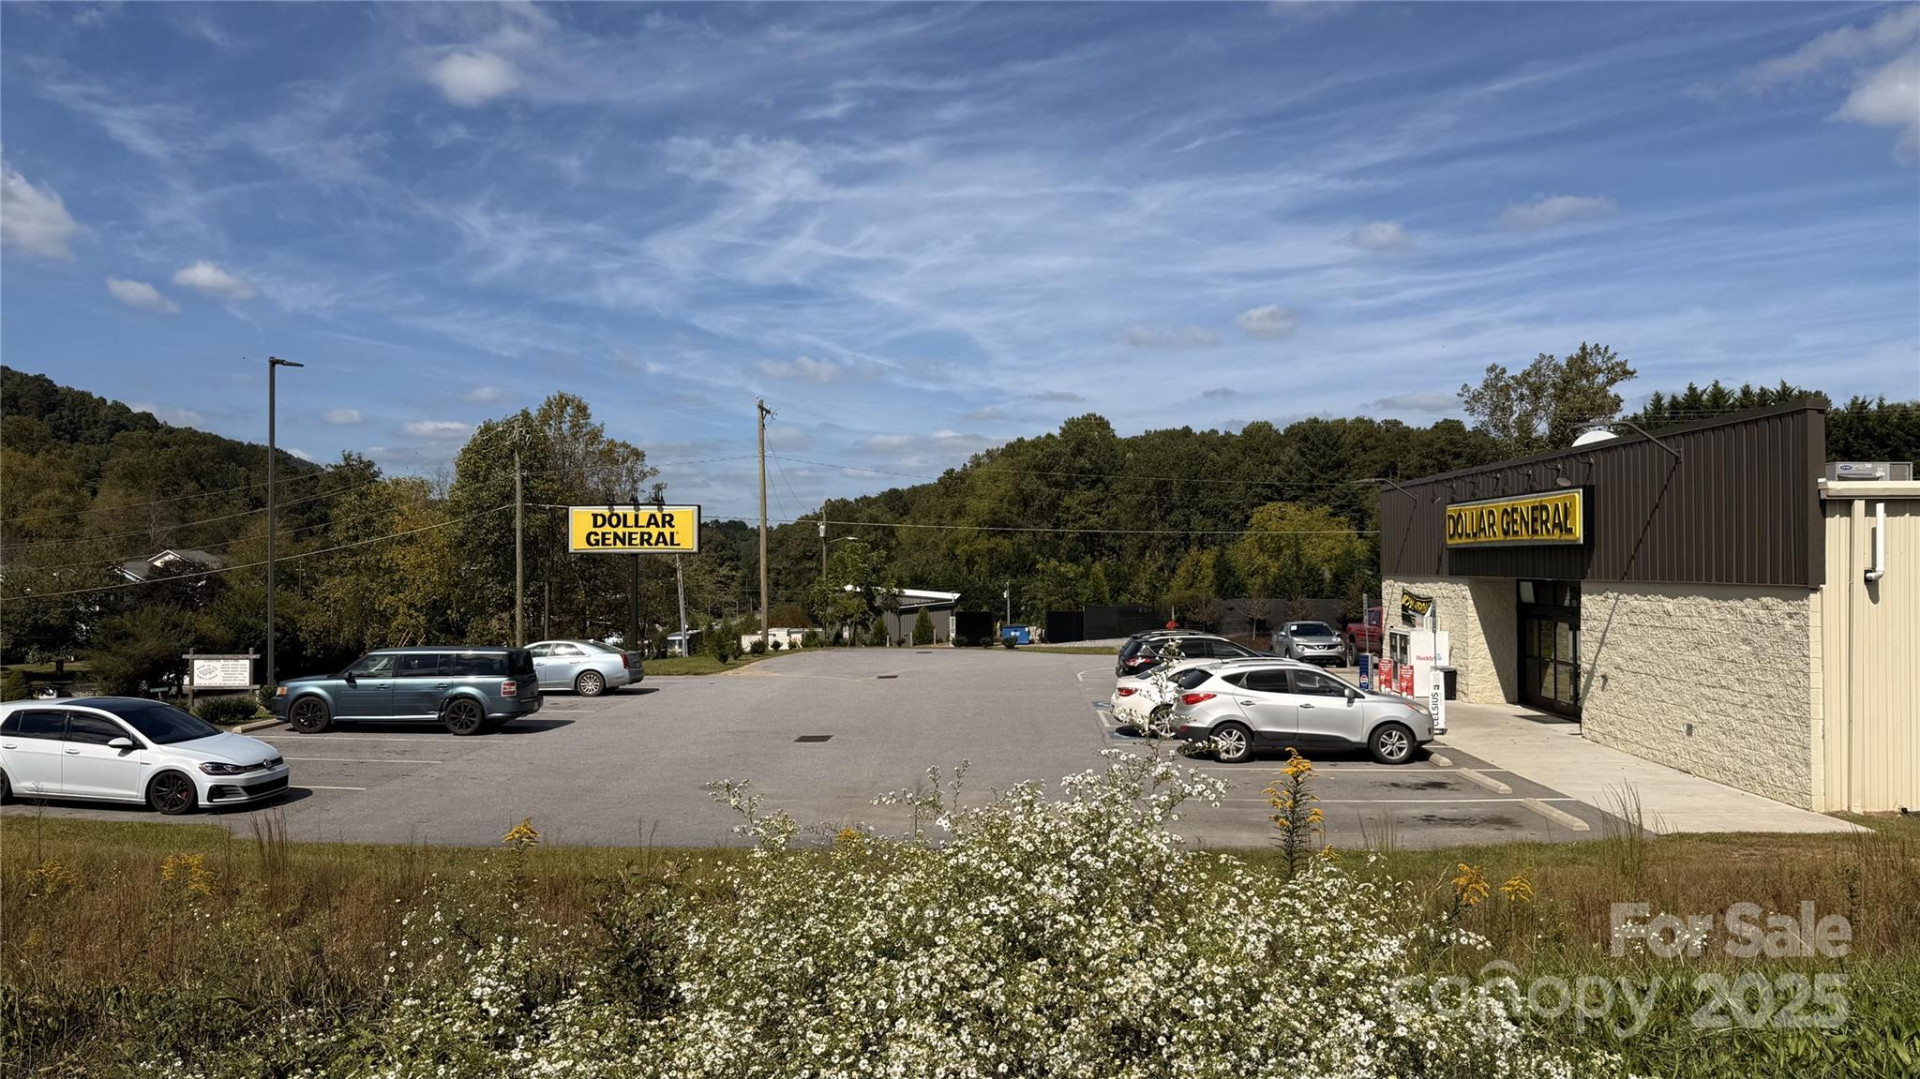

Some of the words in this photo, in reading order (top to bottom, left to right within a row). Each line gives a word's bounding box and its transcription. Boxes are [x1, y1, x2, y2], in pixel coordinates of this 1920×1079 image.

[591, 513, 675, 529] DOLLAR
[1447, 508, 1497, 539] DOLLAR
[1501, 502, 1574, 536] GENERAL
[585, 531, 680, 546] GENERAL
